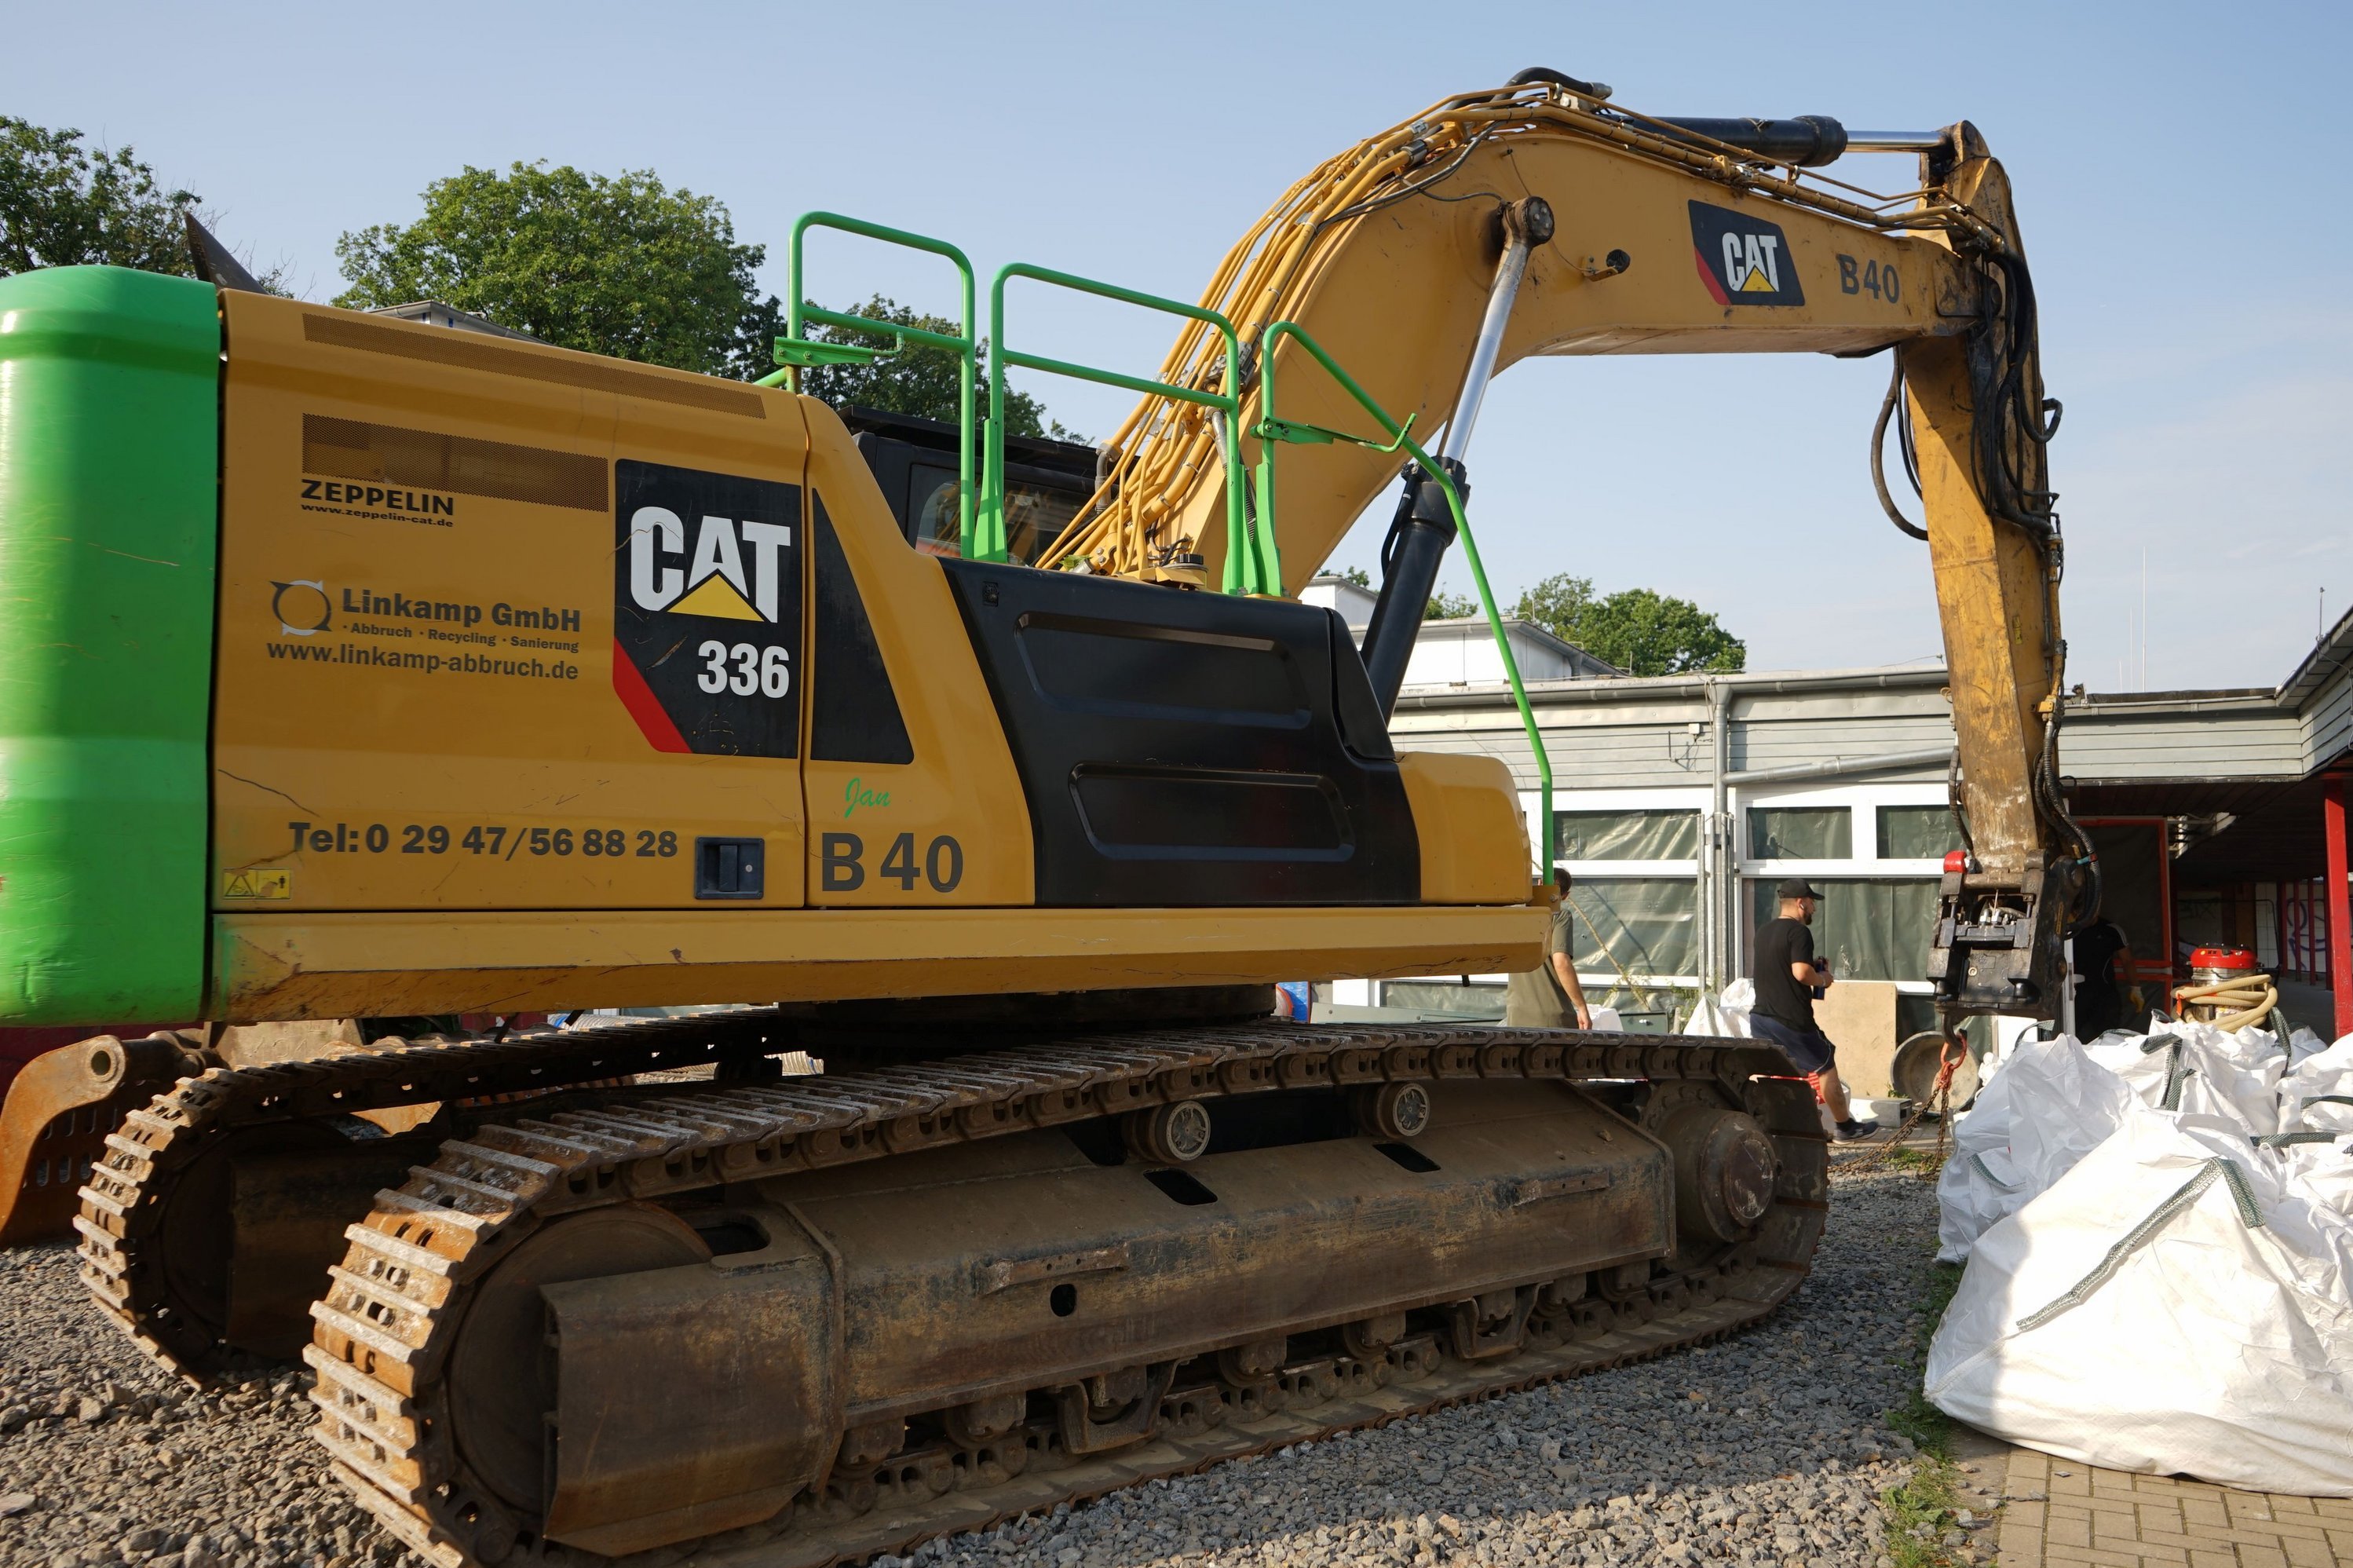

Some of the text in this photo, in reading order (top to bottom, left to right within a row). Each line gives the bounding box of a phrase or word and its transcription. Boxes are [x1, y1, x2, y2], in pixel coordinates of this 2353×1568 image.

[1722, 232, 1780, 292] CAT
[301, 478, 454, 516] ZEPPELIN
[301, 503, 454, 527] www.zeppelin-cat.de
[630, 506, 791, 623] CAT
[342, 588, 581, 632] Linkamp GmbH
[350, 622, 579, 653] Abbruch Recycling Sanierung
[266, 642, 579, 680] www.linkamp-abbruch.de
[697, 640, 790, 699] 336
[843, 777, 891, 818] Jan
[401, 824, 450, 854] 29
[462, 826, 574, 861] 47/56
[583, 828, 626, 857] 88
[636, 830, 678, 857] 28
